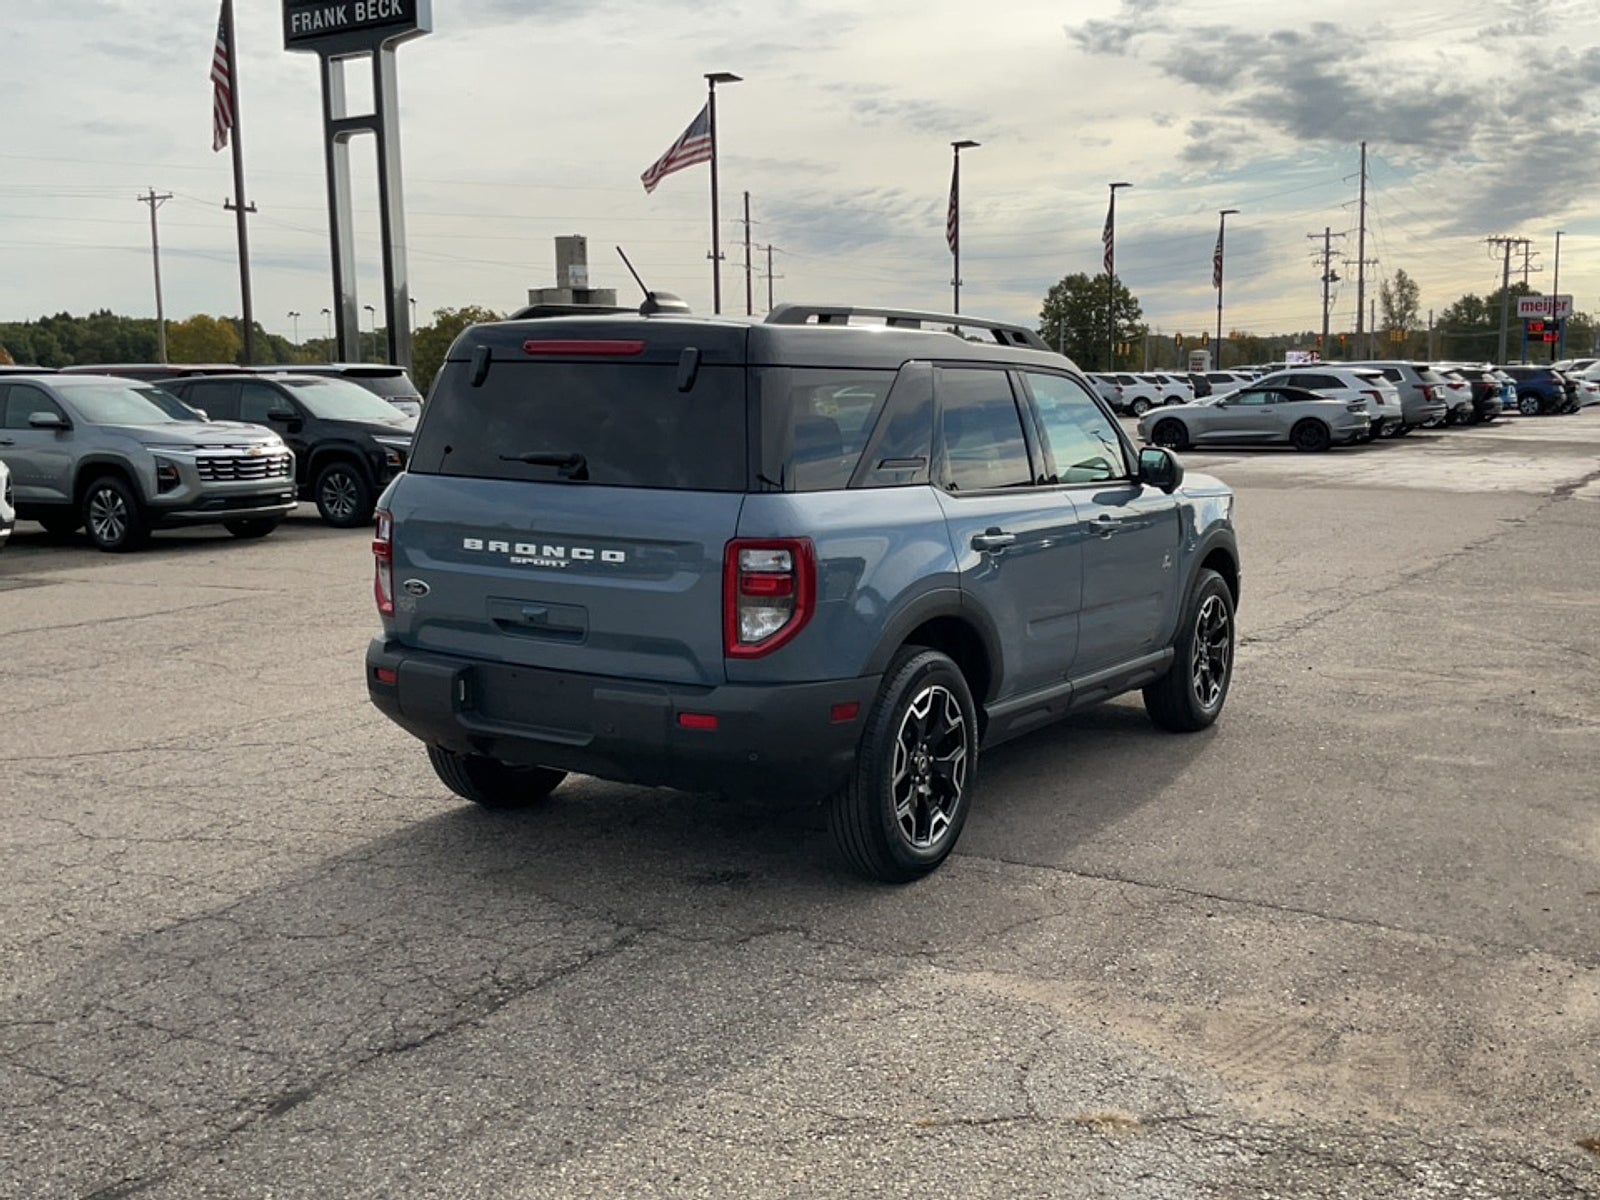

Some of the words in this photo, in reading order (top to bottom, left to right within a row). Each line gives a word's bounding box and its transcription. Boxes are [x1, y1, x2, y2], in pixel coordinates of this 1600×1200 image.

[291, 4, 348, 33] FRANK
[355, 0, 403, 21] BECK
[463, 538, 626, 563] BRONCO
[510, 556, 570, 568] SPORT
